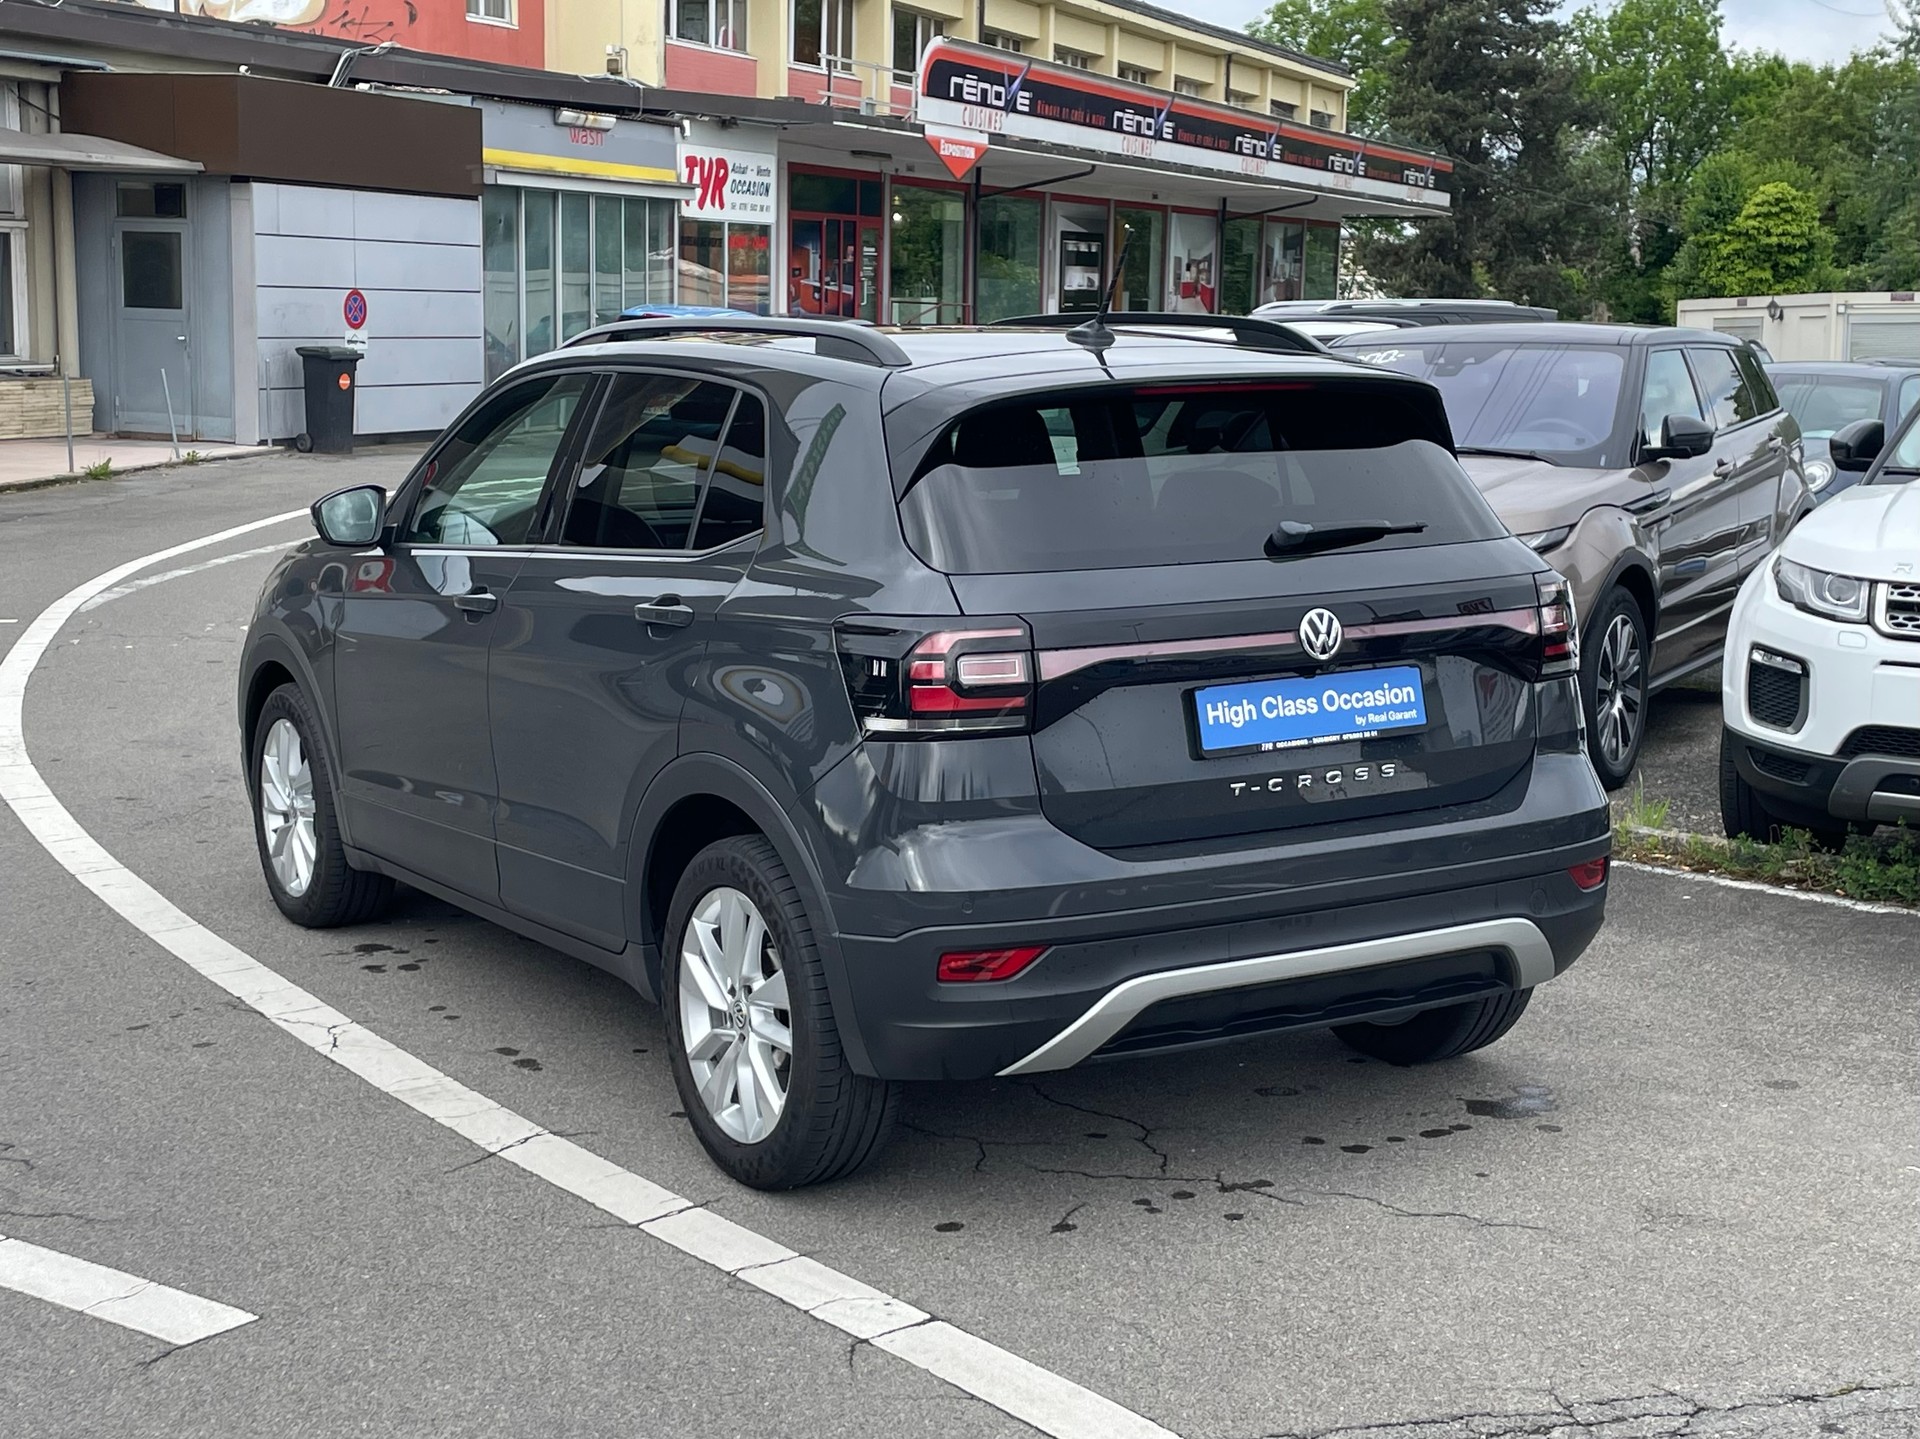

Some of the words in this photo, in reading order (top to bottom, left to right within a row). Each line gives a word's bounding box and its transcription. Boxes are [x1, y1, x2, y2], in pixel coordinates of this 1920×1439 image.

[962, 107, 1003, 131] CUISINES
[685, 156, 729, 211] TYR
[730, 180, 771, 198] OCCASION
[1206, 698, 1258, 728] High
[1261, 694, 1319, 720] Class
[1322, 683, 1416, 712] Occasion
[1355, 714, 1367, 726] by
[1368, 711, 1387, 724] Real
[1388, 708, 1418, 722] Garant
[1230, 763, 1396, 797] T-CROSS
